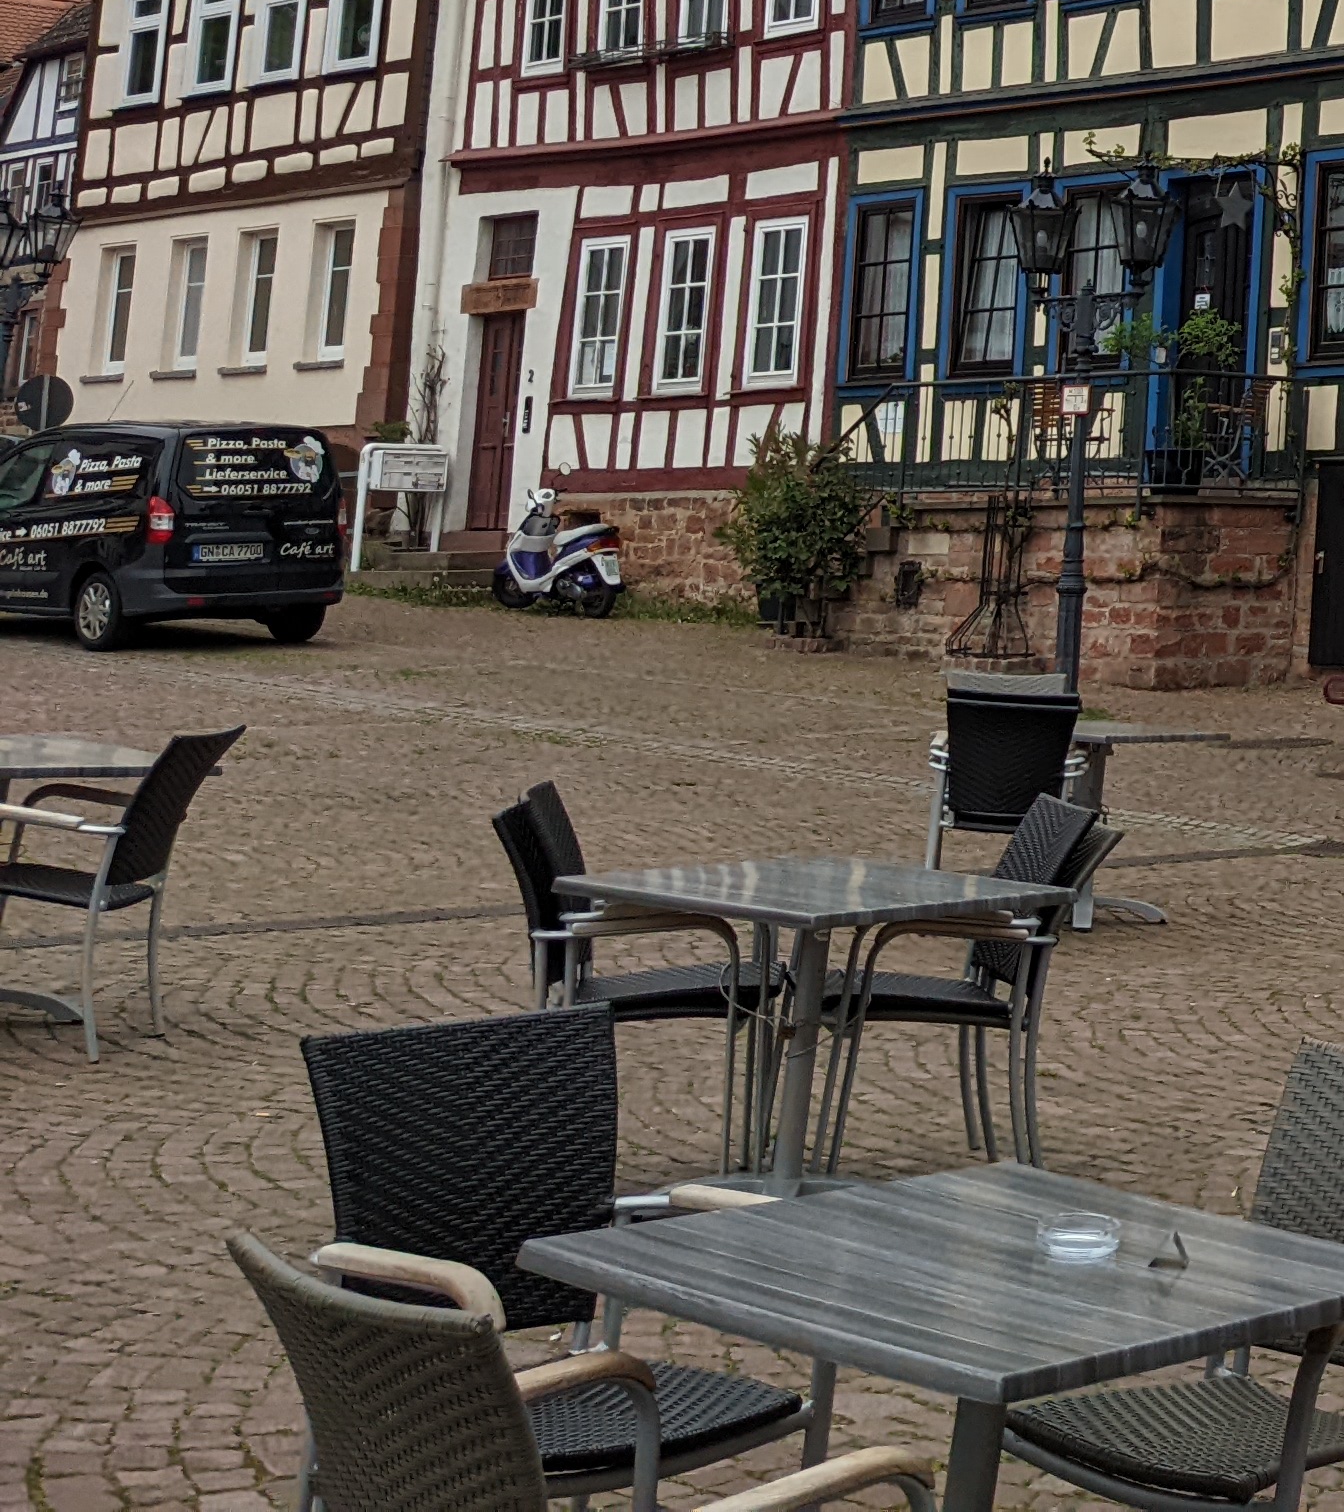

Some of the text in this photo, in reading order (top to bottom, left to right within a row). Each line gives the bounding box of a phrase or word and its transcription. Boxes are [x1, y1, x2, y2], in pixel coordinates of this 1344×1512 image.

[528, 369, 534, 383] 2
[207, 437, 287, 450] Pizza, Pasta
[79, 455, 142, 473] Pizza, Pasta
[205, 453, 256, 464] & more
[205, 468, 288, 480] Lieferservice
[74, 479, 111, 493] & more
[221, 482, 312, 495] 06051 8877792
[30, 522, 59, 538] 06051
[62, 518, 106, 534] 8877792
[201, 544, 262, 557] GN CA 7700
[280, 541, 335, 559] Café art
[28, 550, 48, 566] art
